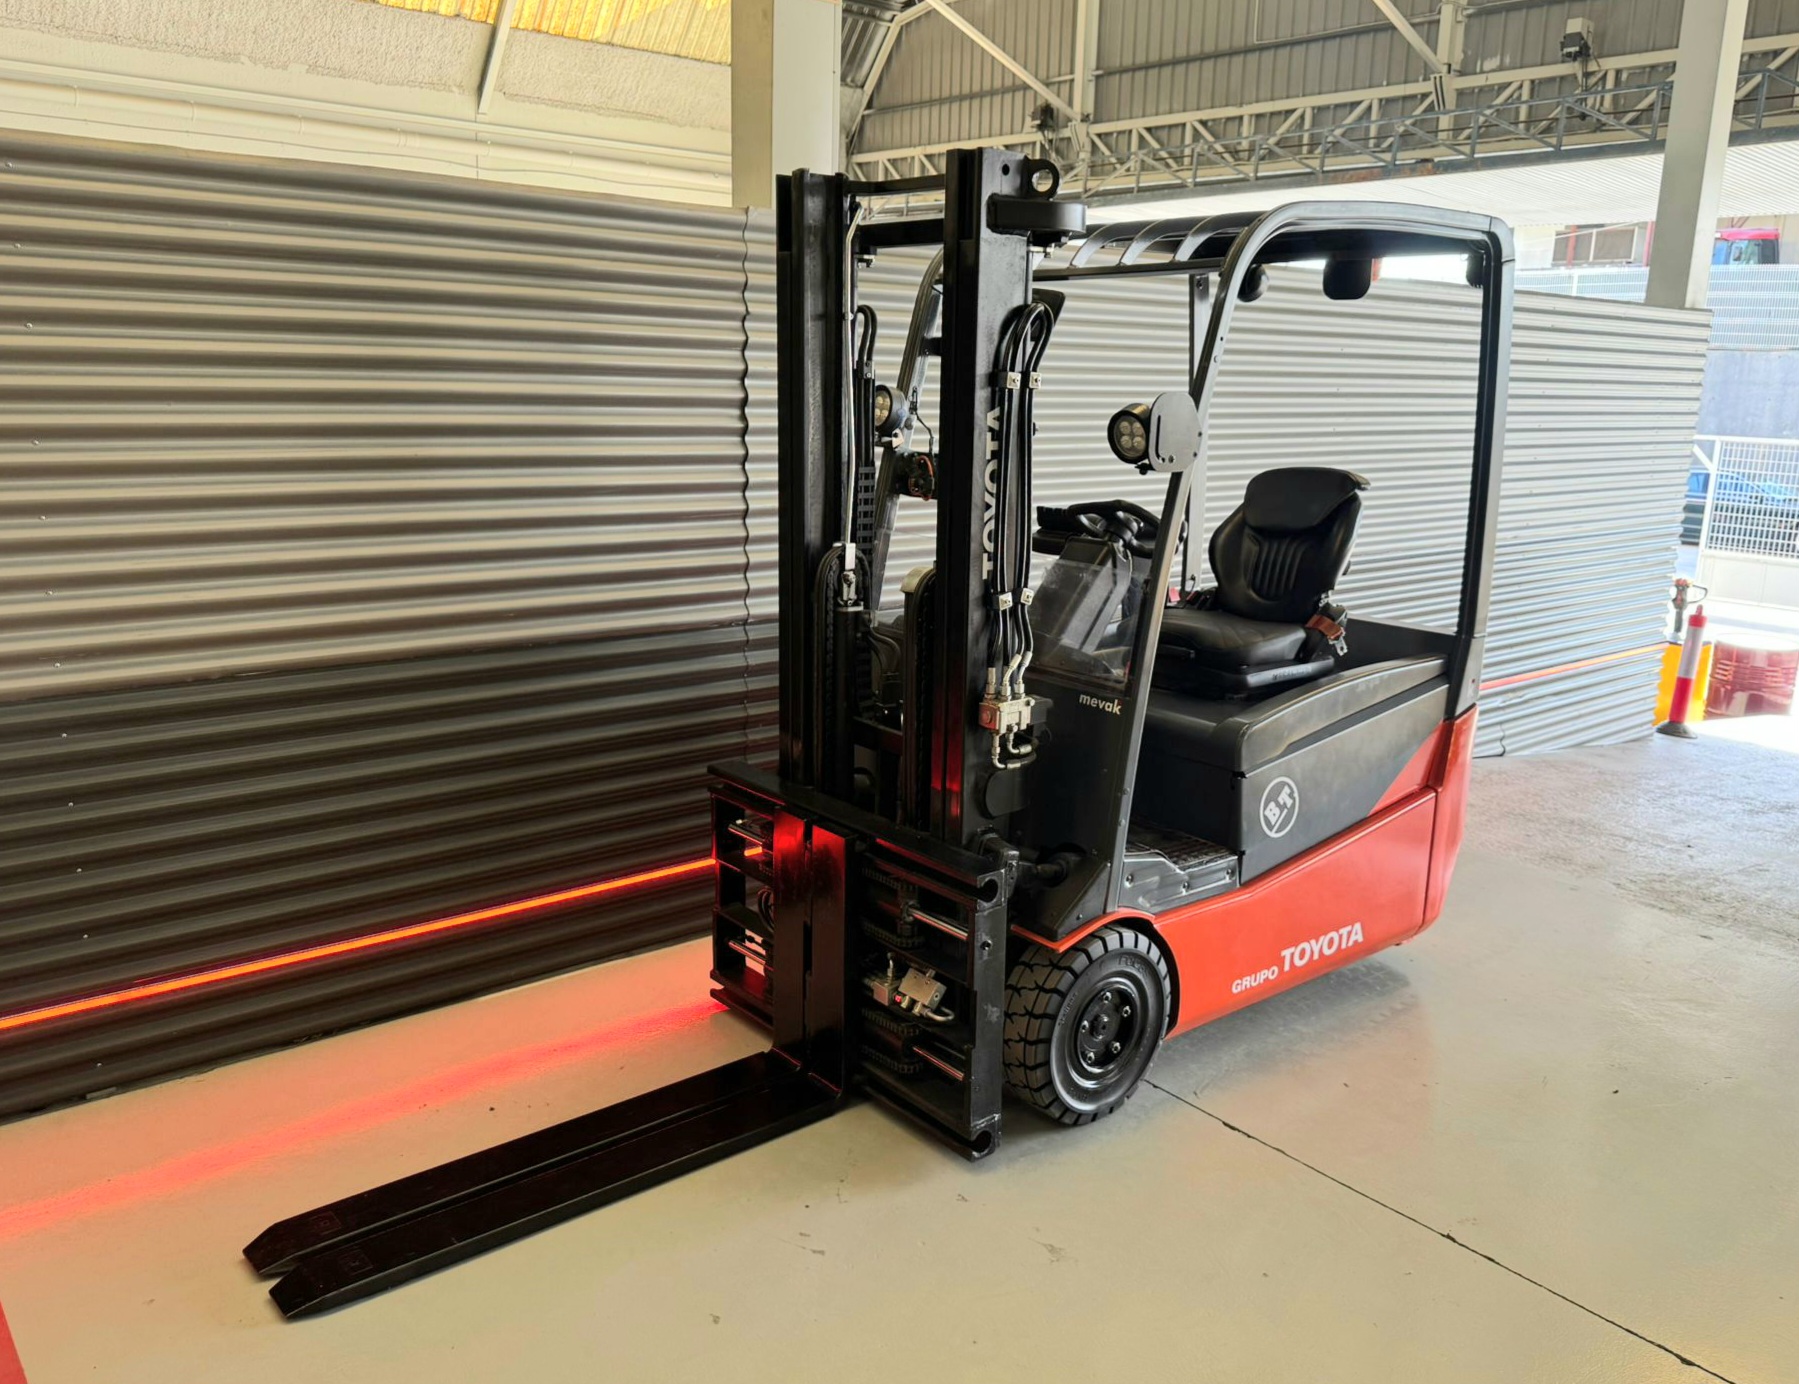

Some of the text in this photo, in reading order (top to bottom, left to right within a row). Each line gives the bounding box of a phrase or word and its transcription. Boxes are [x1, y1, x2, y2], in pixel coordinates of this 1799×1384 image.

[1079, 693, 1122, 715] mevak
[1264, 785, 1293, 826] BT
[1231, 921, 1364, 994] GRUPO TOYOTA
